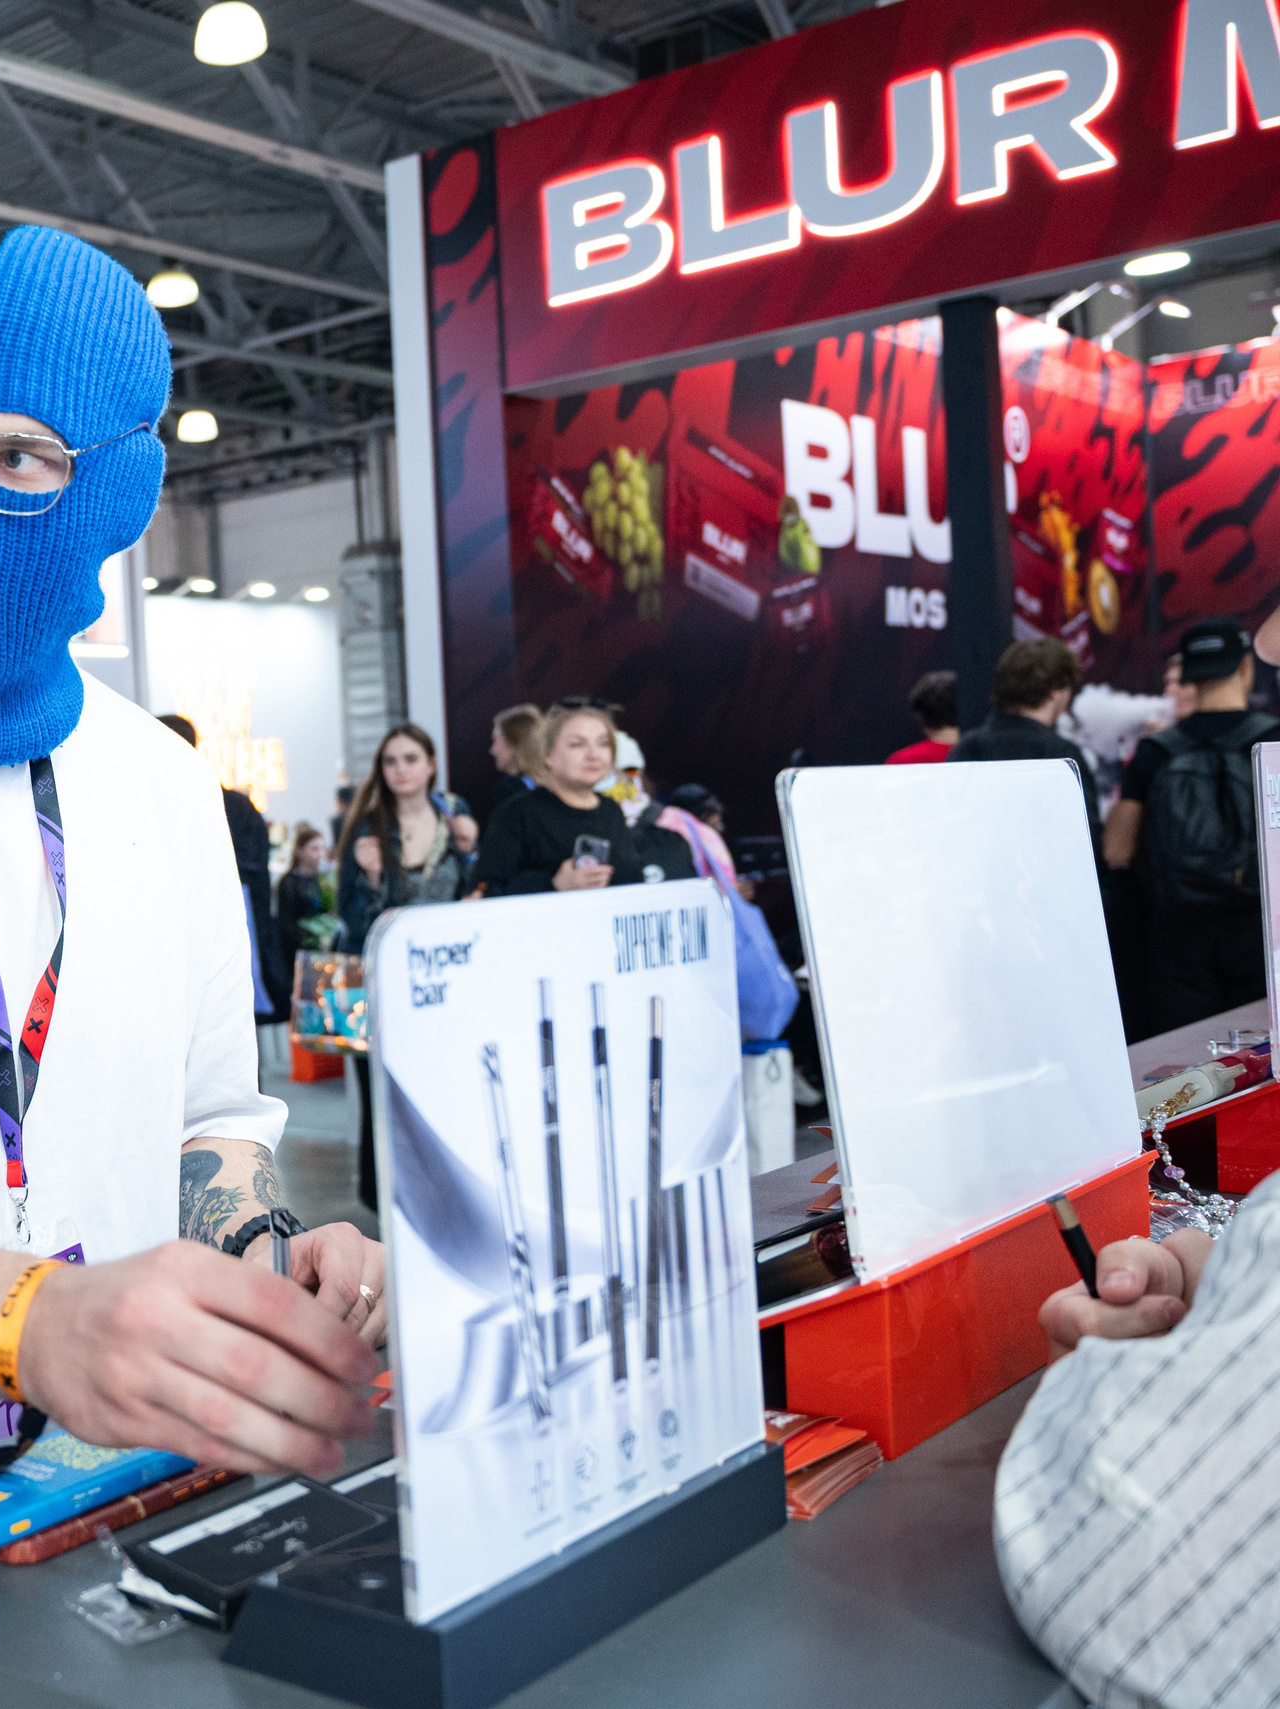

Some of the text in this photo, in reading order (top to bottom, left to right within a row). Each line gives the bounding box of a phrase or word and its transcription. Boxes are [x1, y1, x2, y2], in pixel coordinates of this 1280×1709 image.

[542, 30, 1118, 308] BLUR
[781, 398, 953, 563] BLU
[885, 585, 948, 630] MOS
[407, 938, 472, 977] hyper
[613, 909, 674, 974] SUPREME
[409, 977, 448, 1008] bar
